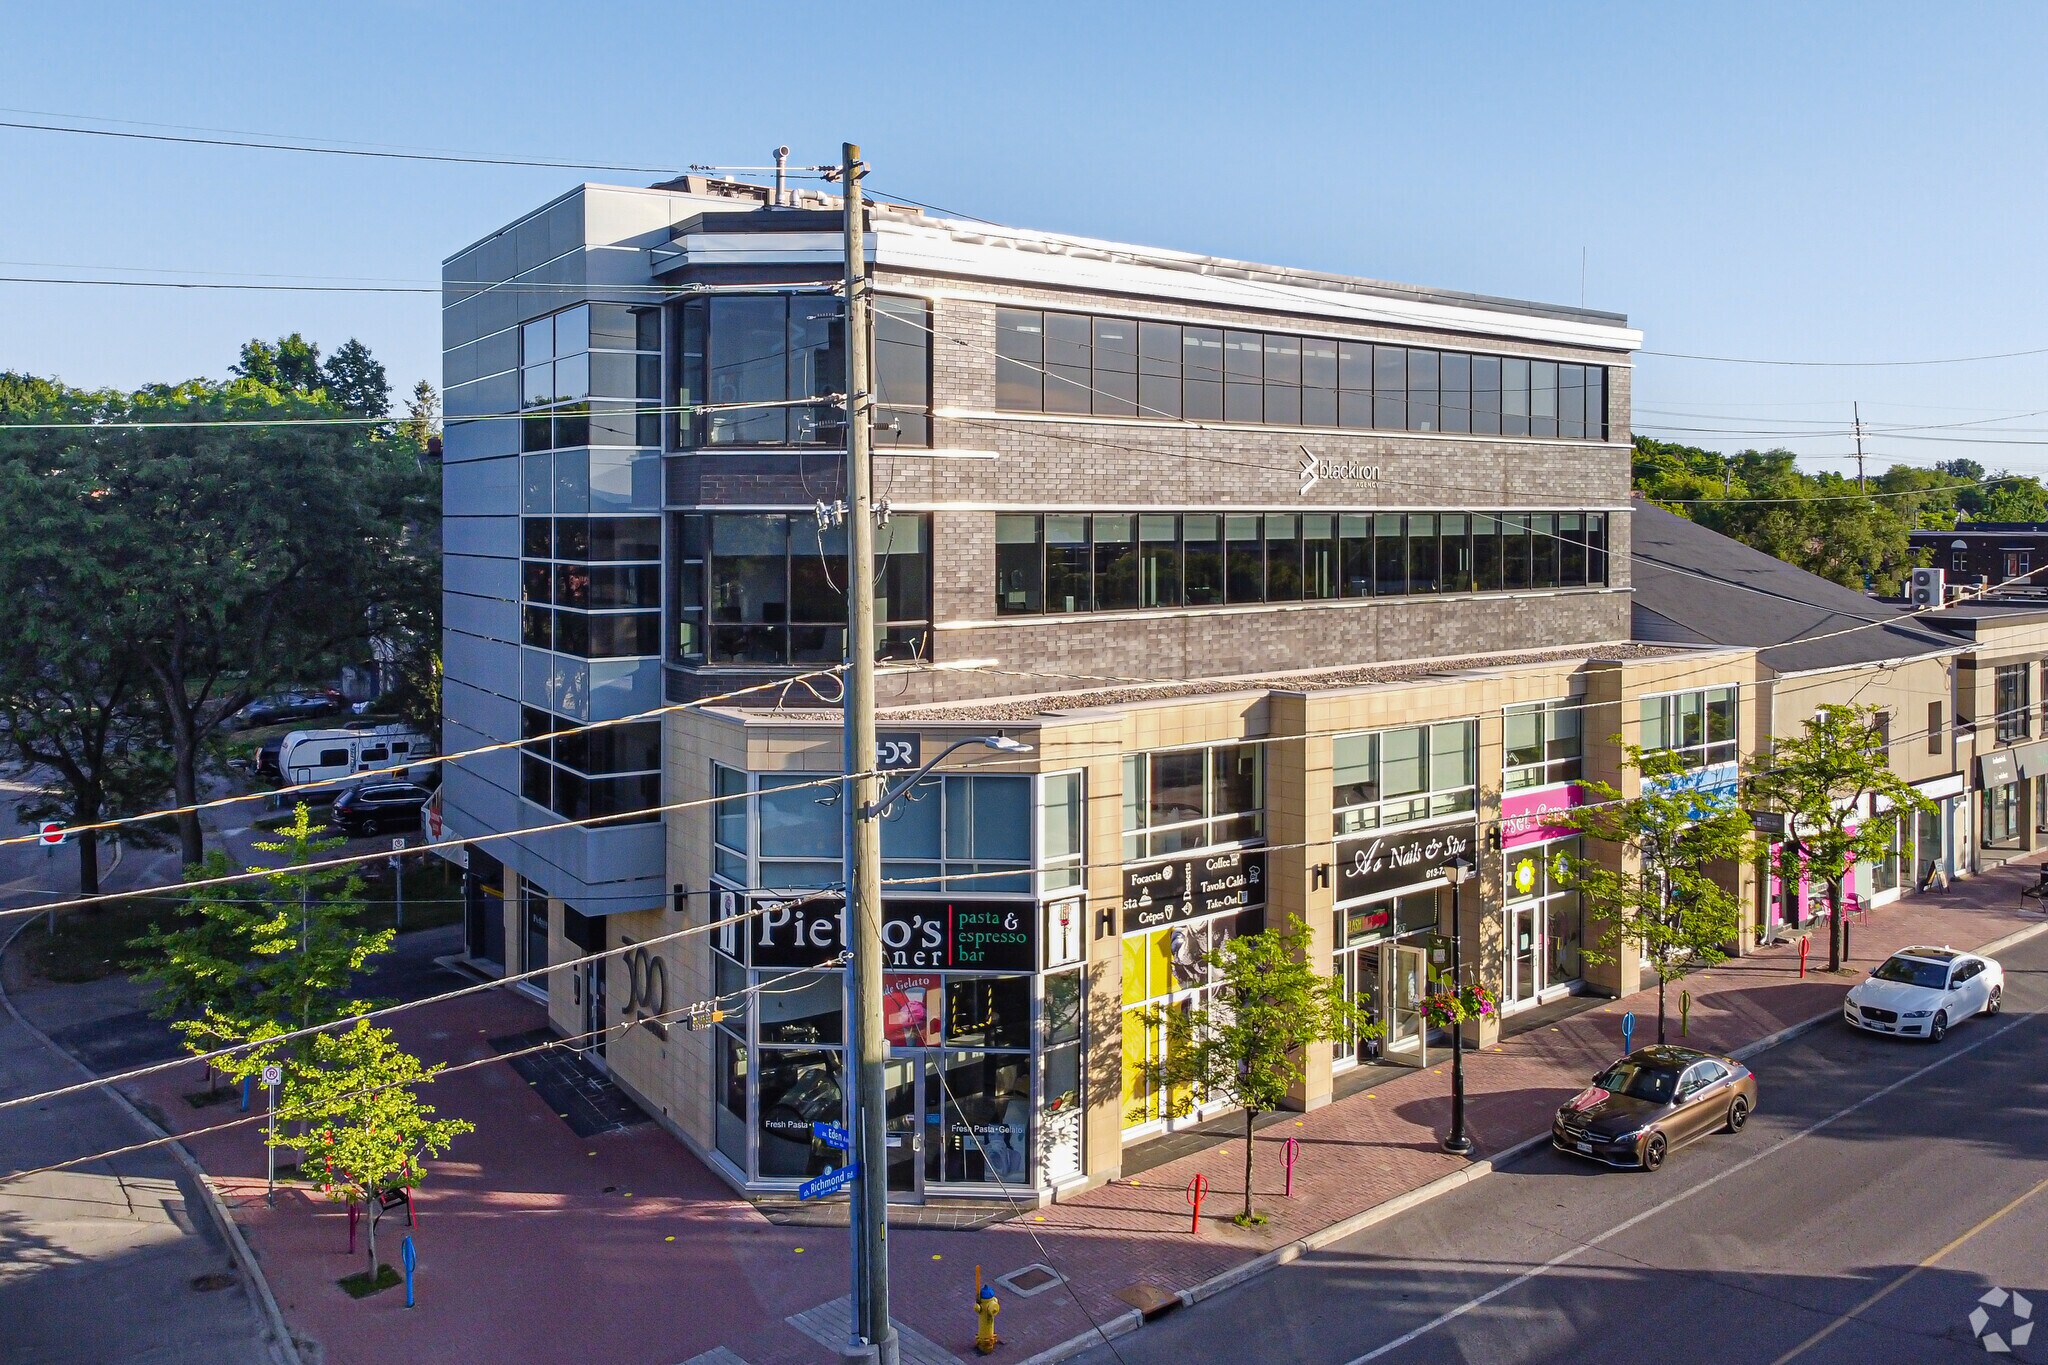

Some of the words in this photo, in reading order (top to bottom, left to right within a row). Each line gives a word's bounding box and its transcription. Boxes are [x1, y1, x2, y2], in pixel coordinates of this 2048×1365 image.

[1318, 460, 1380, 480] blackiron
[1389, 842, 1422, 869] Nails
[1425, 838, 1442, 860] &
[1206, 855, 1231, 871] Coffee
[1131, 871, 1162, 886] Focaccia
[1183, 862, 1192, 901] Desserts
[1201, 878, 1226, 893] Tavola
[1123, 898, 1138, 911] sta
[1206, 895, 1238, 910] Take-Out
[757, 900, 942, 948] Pieto's
[958, 911, 1000, 930] pasta
[1004, 912, 1019, 930] &
[958, 931, 1027, 949] espresso
[958, 944, 985, 962] bar
[895, 977, 930, 990] Gelato
[765, 1120, 786, 1128] Fresh
[951, 1124, 973, 1133] Fresh
[828, 1128, 843, 1142] Eden
[810, 1170, 845, 1194] Richmond
